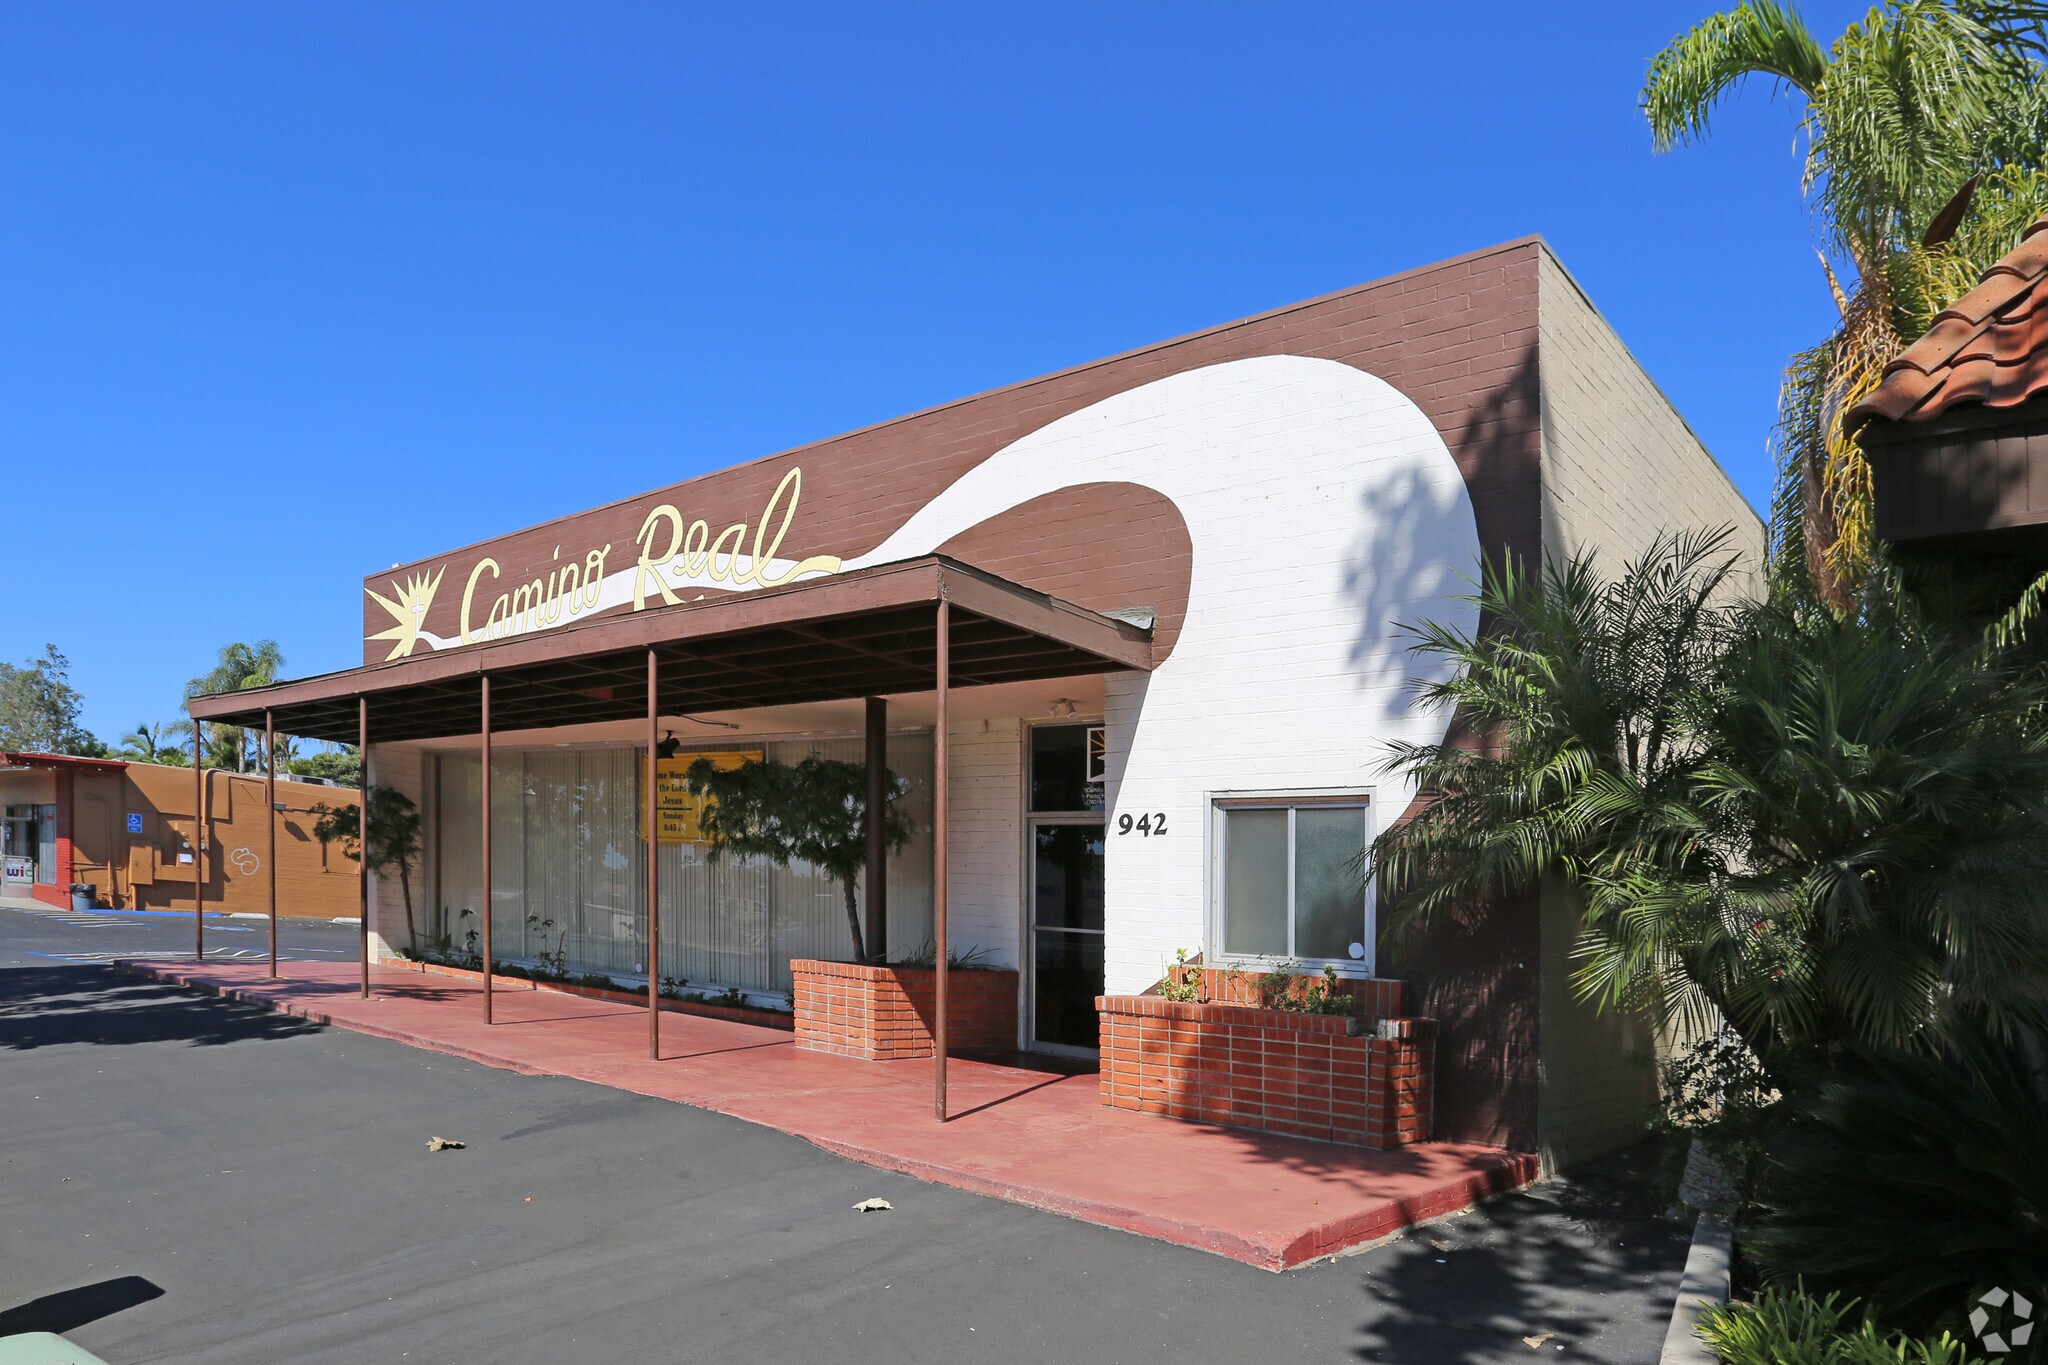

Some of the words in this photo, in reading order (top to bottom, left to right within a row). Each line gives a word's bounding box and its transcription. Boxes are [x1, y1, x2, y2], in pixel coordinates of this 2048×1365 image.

[460, 543, 611, 646] Camino
[633, 466, 842, 612] Real
[659, 783, 670, 792] the
[672, 783, 687, 792] Lord
[662, 796, 682, 805] Jesus
[662, 811, 684, 822] Sunday
[664, 823, 677, 832] 8:45
[1118, 812, 1168, 838] 942
